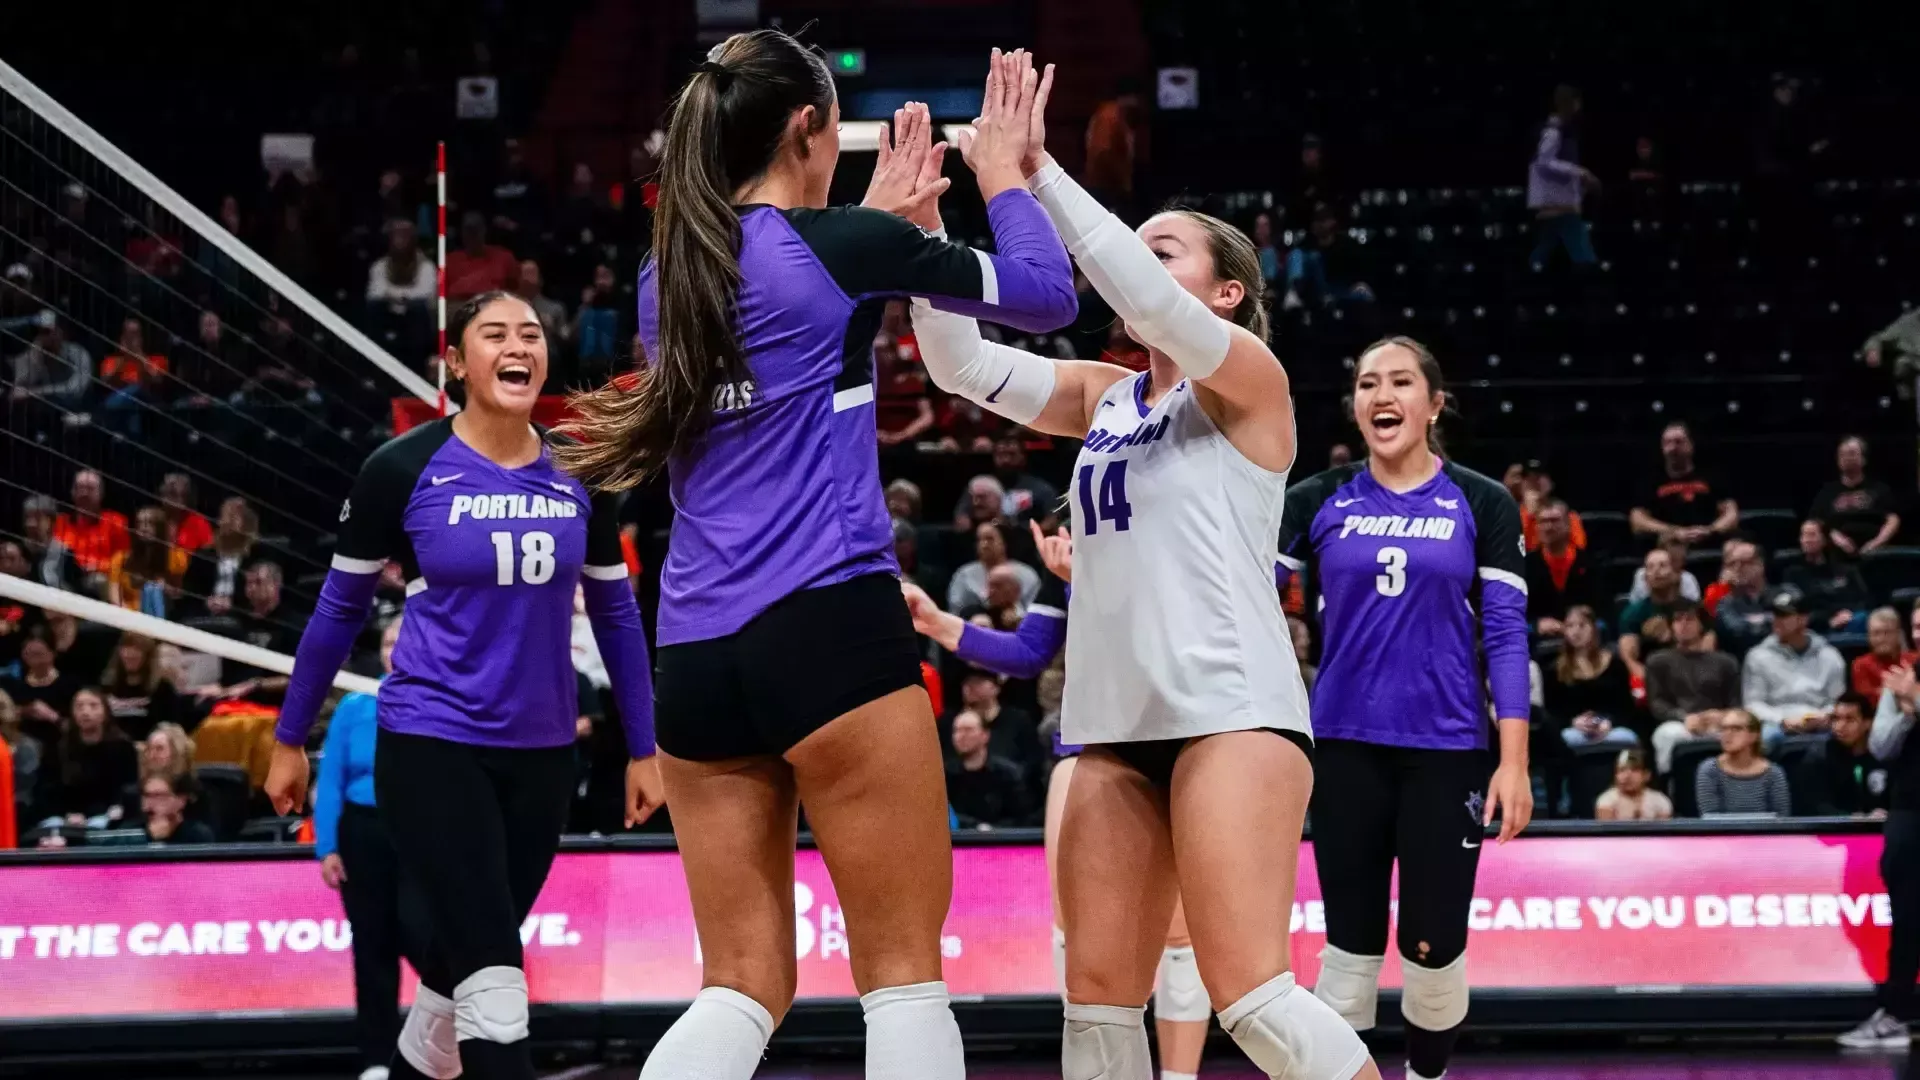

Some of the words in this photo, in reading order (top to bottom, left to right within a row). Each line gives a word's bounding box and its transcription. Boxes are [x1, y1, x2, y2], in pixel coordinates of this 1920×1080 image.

[448, 494, 577, 525] PORTLAND
[1078, 459, 1132, 536] 14
[1339, 515, 1456, 541] PORTLAND
[491, 531, 556, 586] 18
[1375, 546, 1408, 597] 3
[1467, 897, 1582, 930] CARE
[1588, 896, 1685, 929] YOU
[1695, 893, 1893, 927] DESERVE
[30, 924, 120, 958] THE
[127, 921, 250, 956] CARE
[258, 918, 353, 953] YOU
